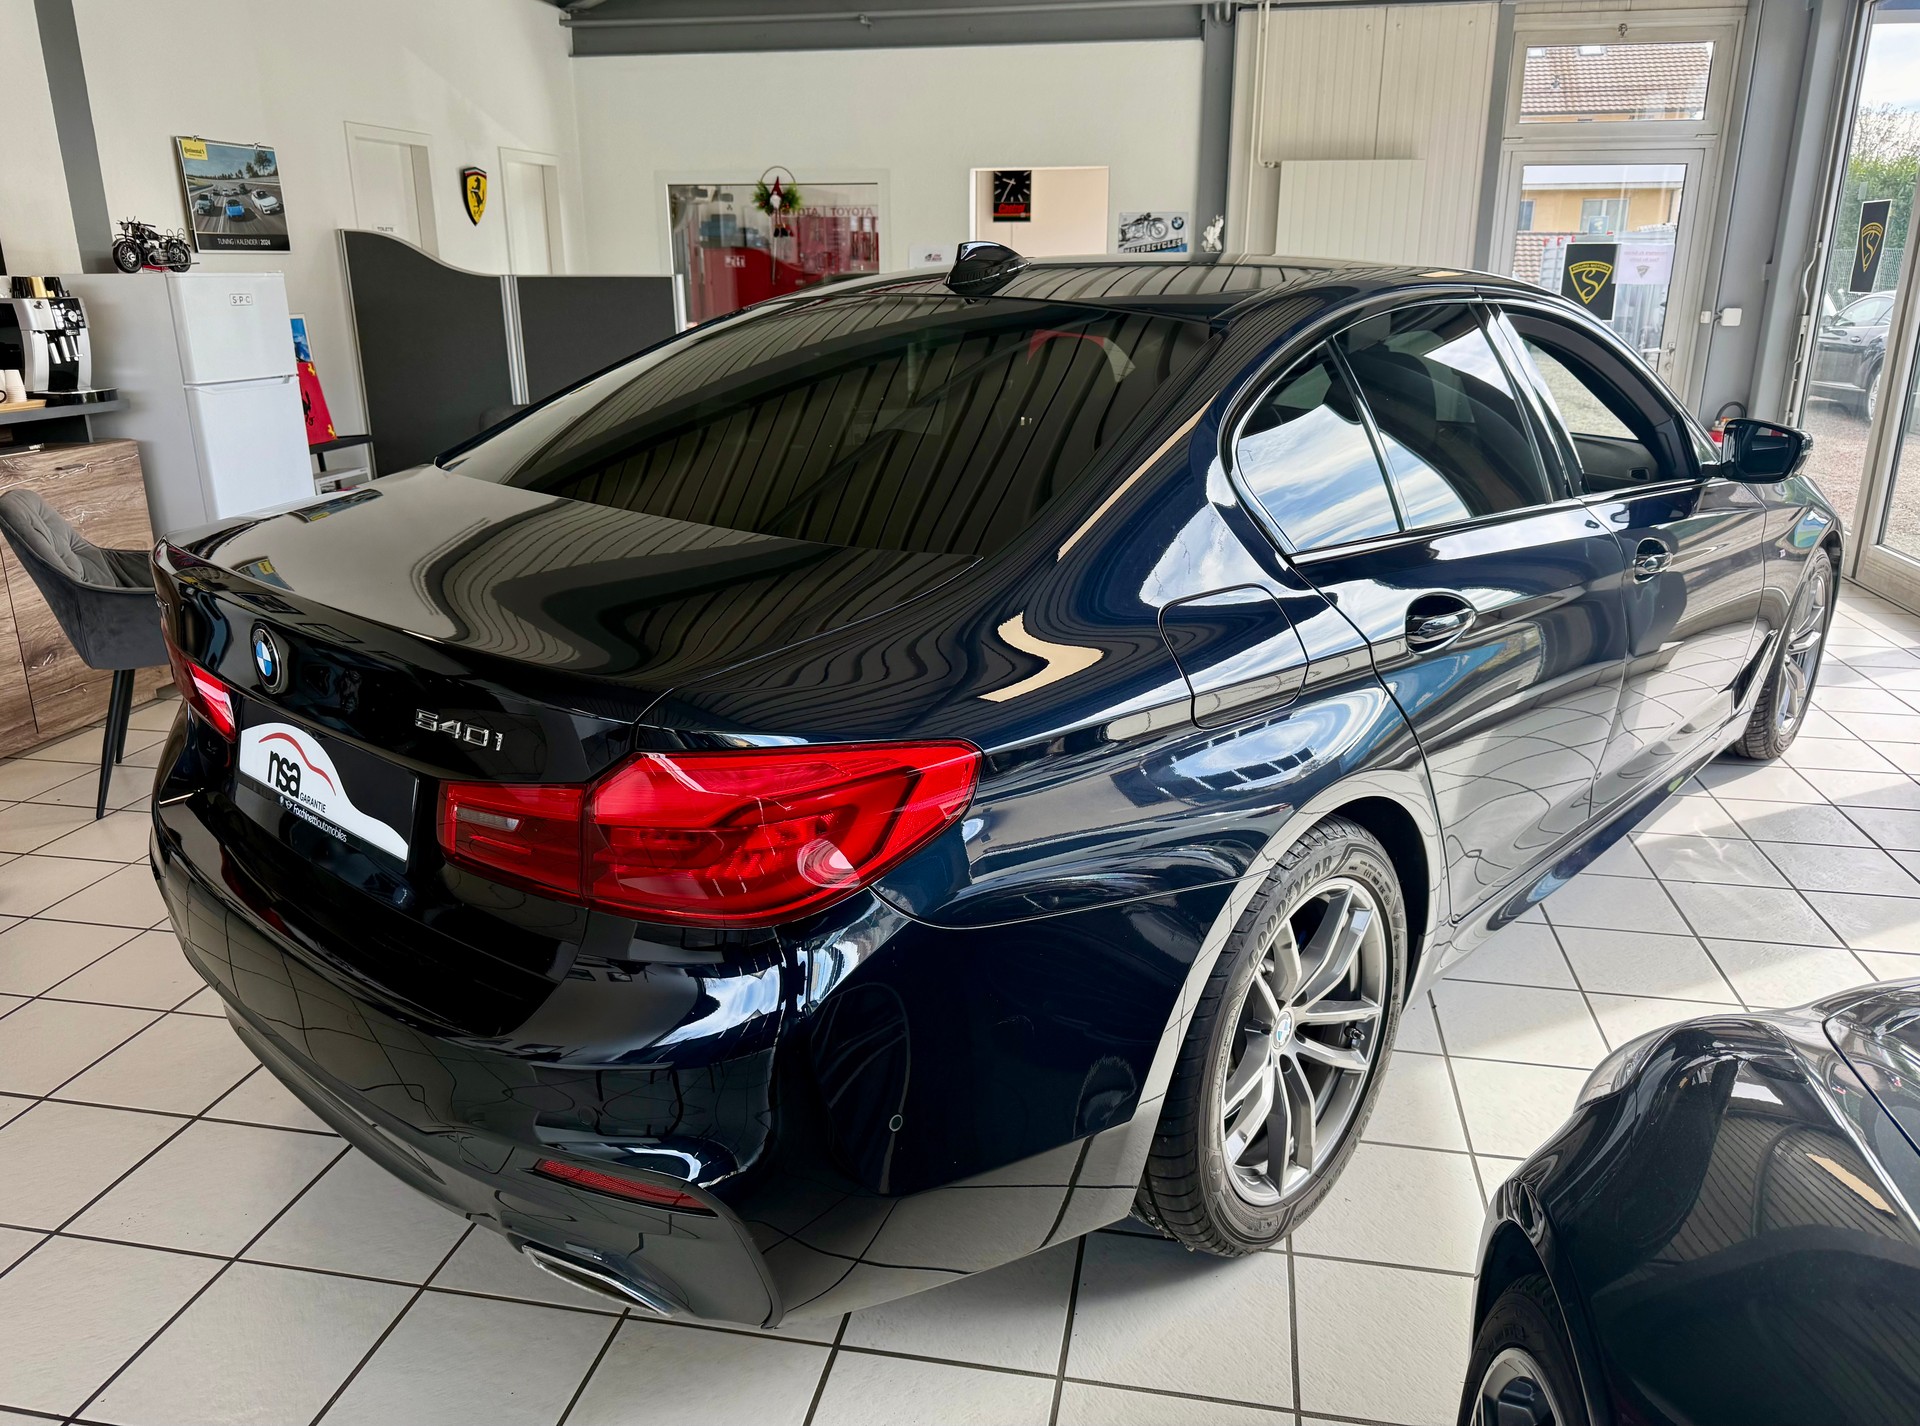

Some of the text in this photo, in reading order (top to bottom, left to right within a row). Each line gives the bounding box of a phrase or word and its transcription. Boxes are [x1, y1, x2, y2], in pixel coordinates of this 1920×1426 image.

[831, 207, 873, 216] TOYOTA
[267, 750, 301, 799] nsa
[300, 792, 327, 814] GARANTIE
